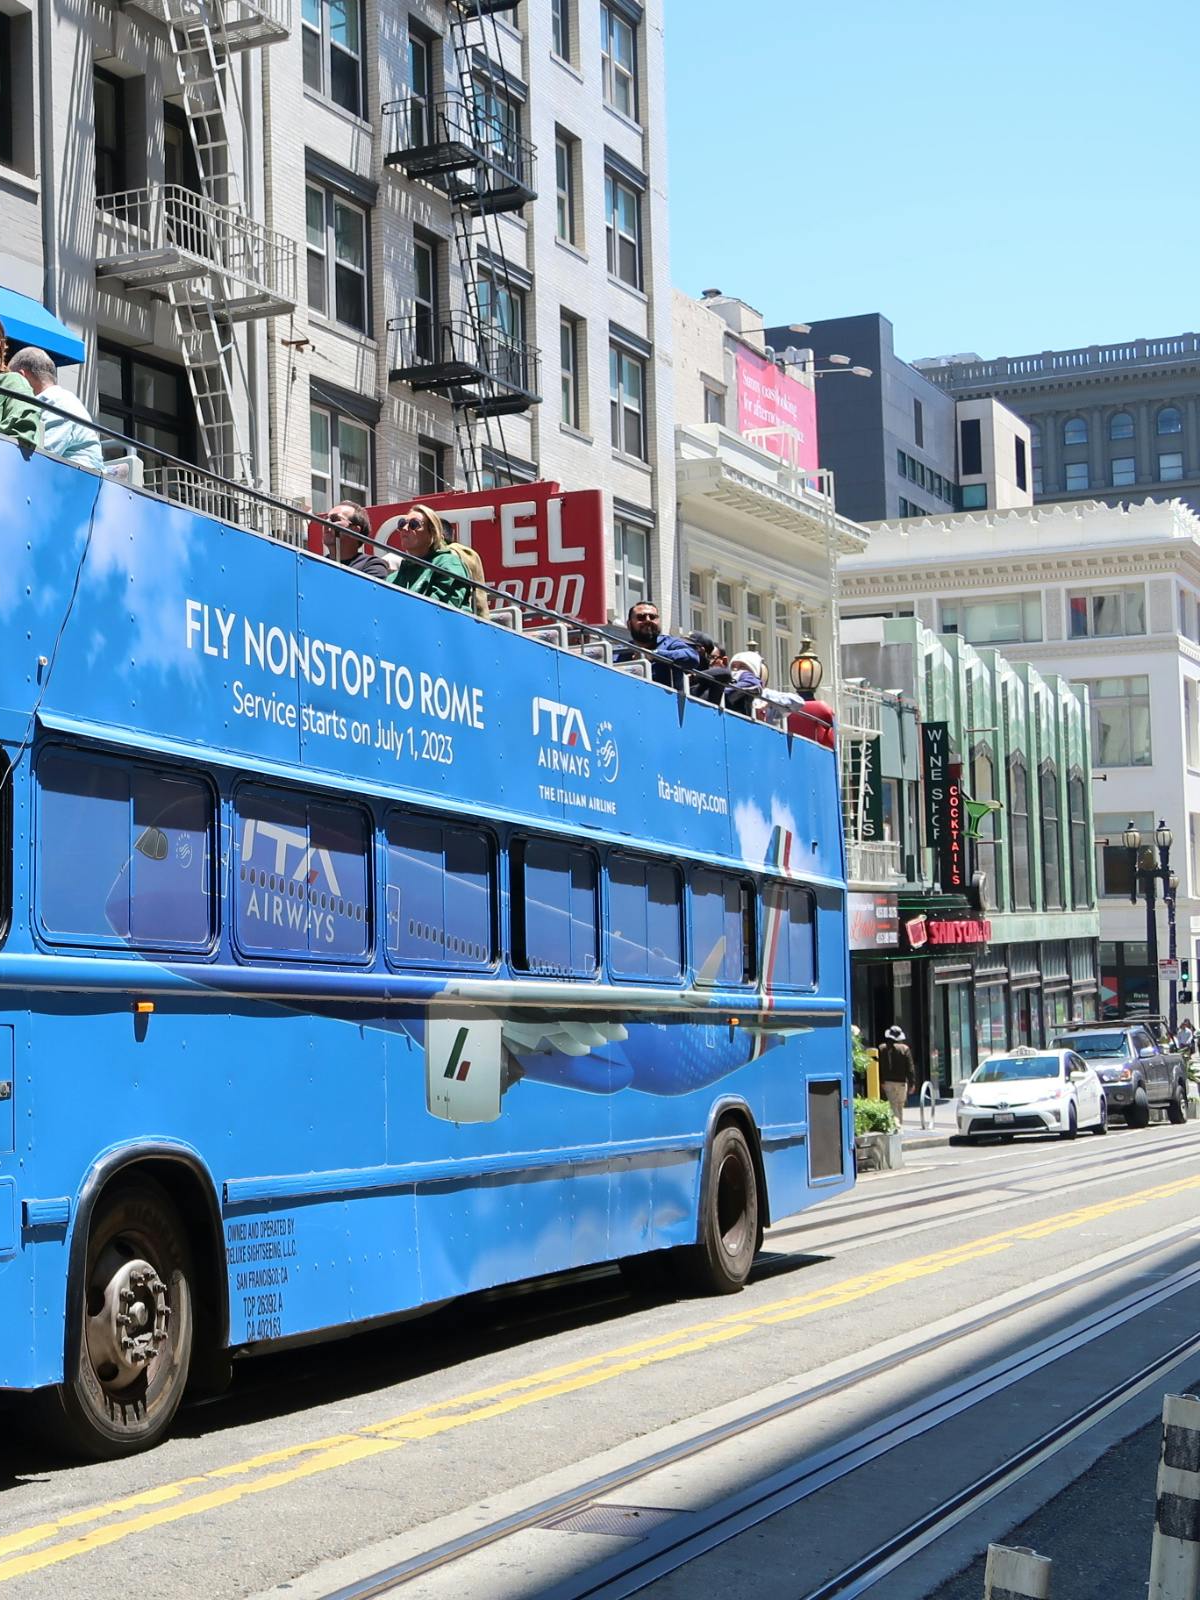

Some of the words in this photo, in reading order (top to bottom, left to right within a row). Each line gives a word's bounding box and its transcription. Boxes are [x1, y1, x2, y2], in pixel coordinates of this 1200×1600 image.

[185, 598, 236, 660] FLY
[244, 616, 376, 699] NONSTOP
[380, 660, 414, 710] TO
[420, 672, 485, 730] ROME
[232, 680, 297, 728] Service
[301, 705, 347, 741] starts
[351, 720, 371, 746] on
[374, 719, 403, 760] July
[407, 726, 418, 760] 1,
[421, 729, 454, 764] 2023
[532, 696, 592, 752] ITA
[538, 746, 591, 778] AIRWAYS
[927, 729, 943, 781] WINE
[539, 784, 556, 802] THE
[557, 788, 587, 809] ITALIAN
[588, 797, 617, 815] AIRLINE
[657, 773, 728, 815] ita-airways.com
[859, 742, 876, 836] CKTAILS
[241, 818, 341, 896] ITA
[950, 785, 960, 885] COCKTAILS
[246, 889, 335, 943] AIRWAYS
[227, 1222, 247, 1243] OWNED
[249, 1221, 259, 1240] AND
[260, 1219, 286, 1239] OPERATED
[288, 1218, 295, 1235] BY
[227, 1245, 246, 1265] DELUXE
[247, 1240, 282, 1263] SIGHTSEEING,
[236, 1272, 248, 1291] SAN
[249, 1268, 280, 1289] FRANCISCO,
[281, 1266, 288, 1283] CA
[243, 1297, 255, 1318] TCP
[278, 1292, 284, 1313] A
[246, 1320, 255, 1340] CA
